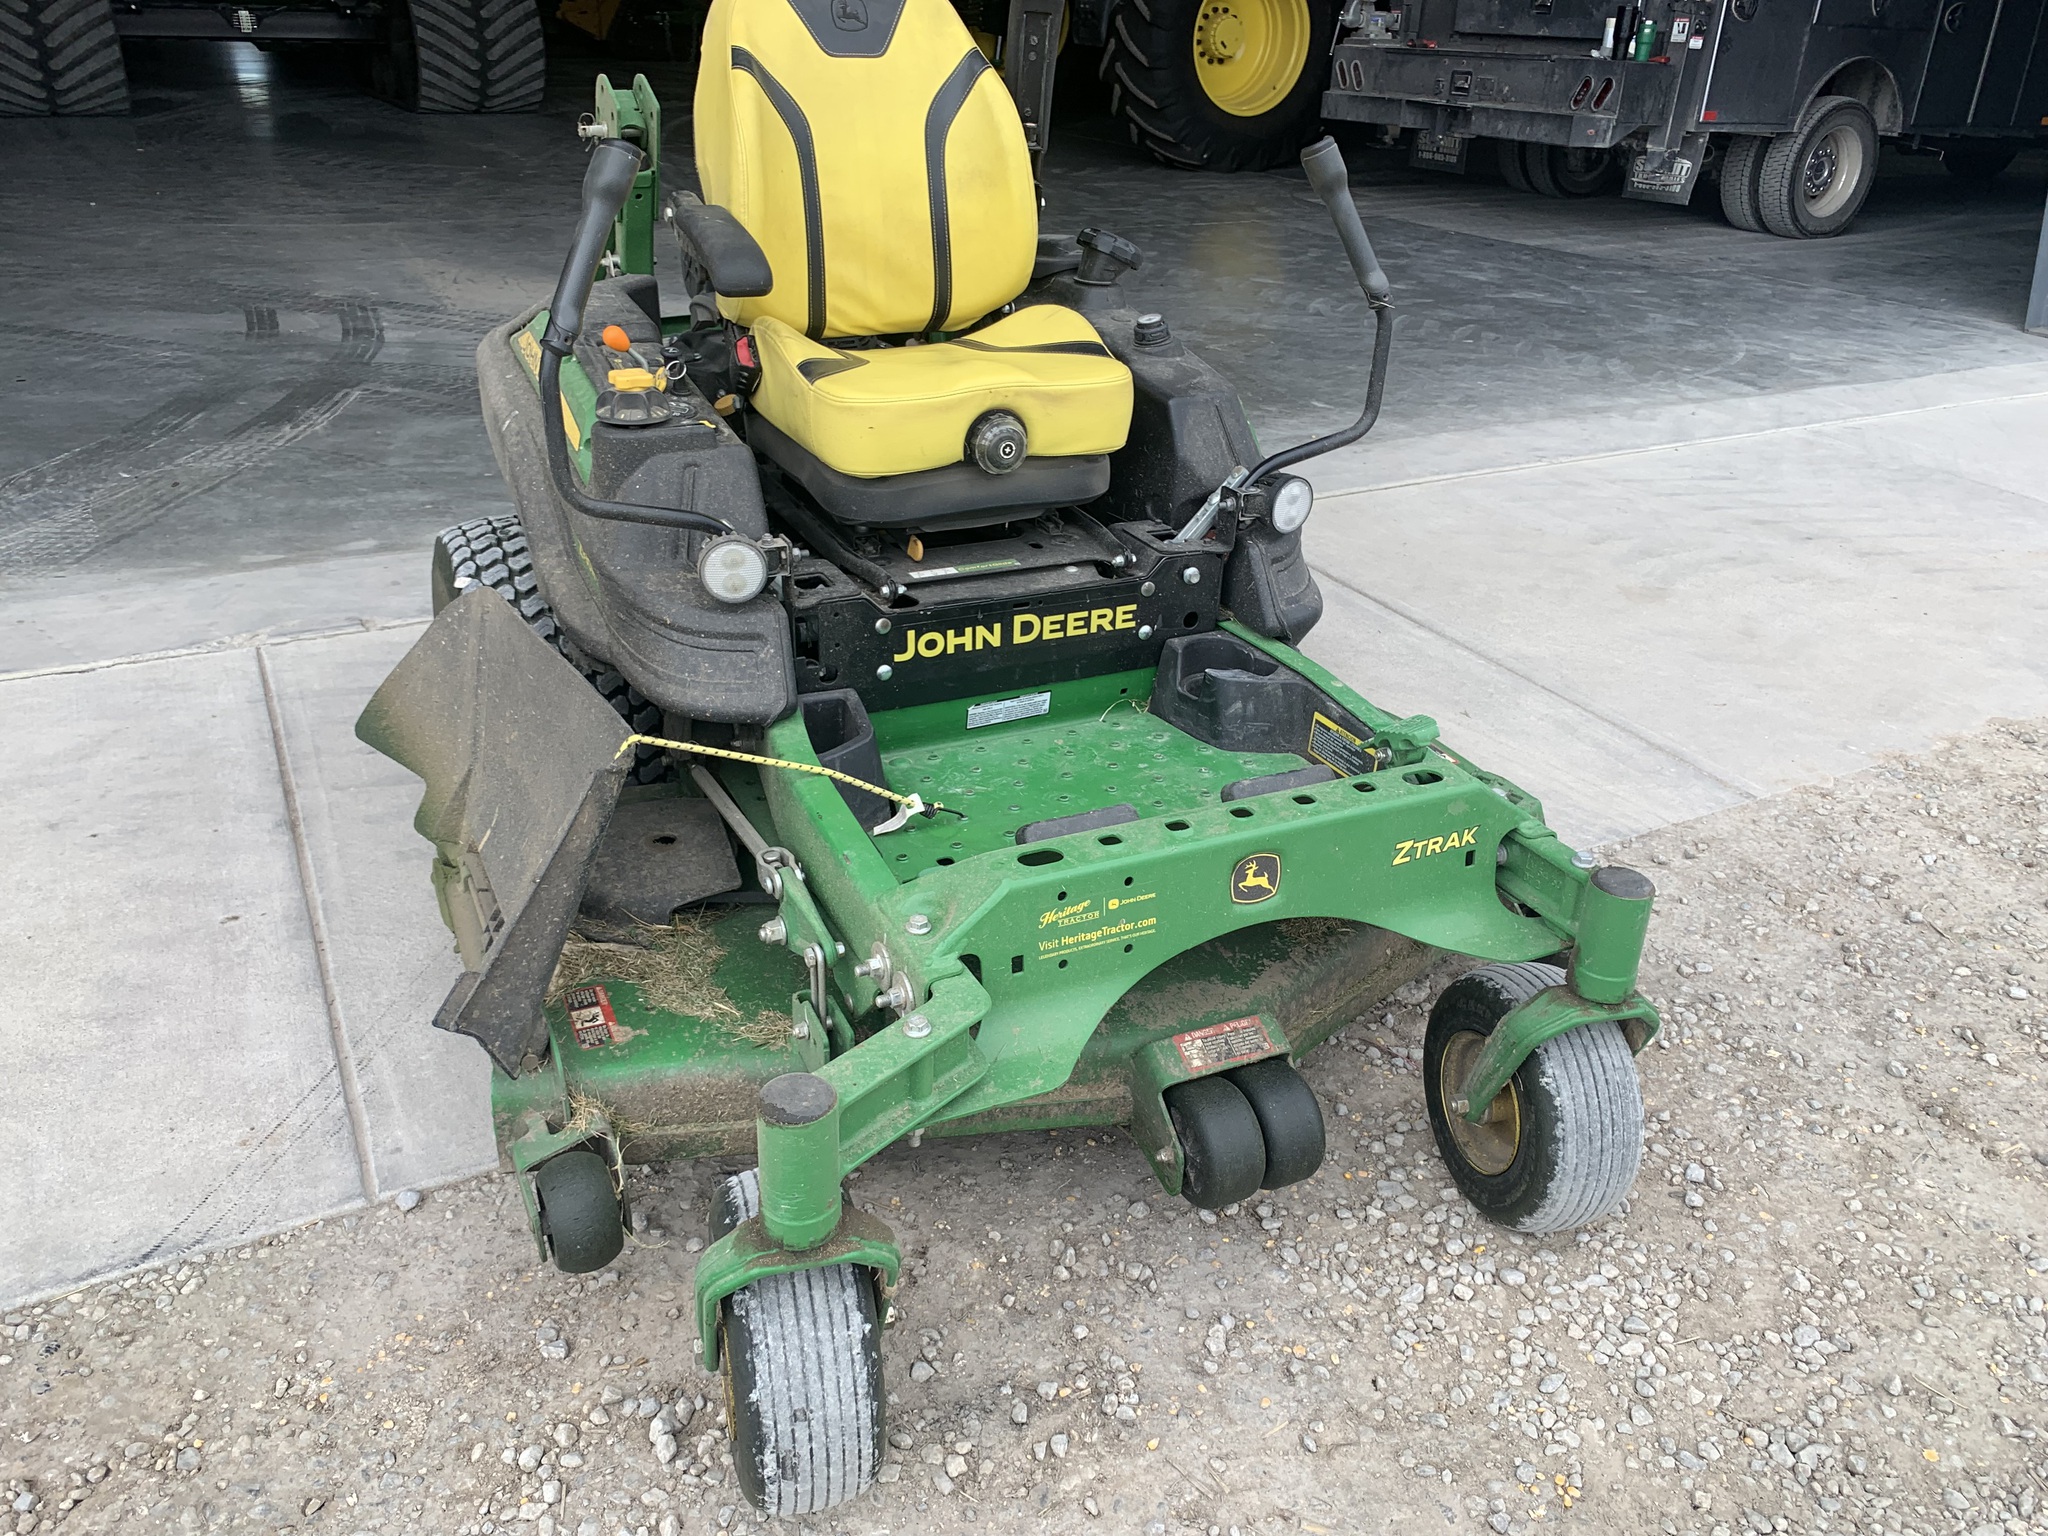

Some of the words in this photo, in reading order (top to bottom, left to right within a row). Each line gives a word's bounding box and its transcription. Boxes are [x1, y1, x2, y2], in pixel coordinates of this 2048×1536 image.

[893, 622, 1002, 663] JOHN
[1012, 603, 1138, 645] DEERE
[1391, 825, 1481, 867] ZTRAK
[1038, 899, 1091, 929] Heritage
[1119, 897, 1136, 905] JOHN
[1136, 893, 1156, 902] DEERE
[1039, 939, 1060, 951] Visit
[1061, 917, 1157, 946] HeritageTractor.com
[1058, 910, 1100, 927] TRACTOR
